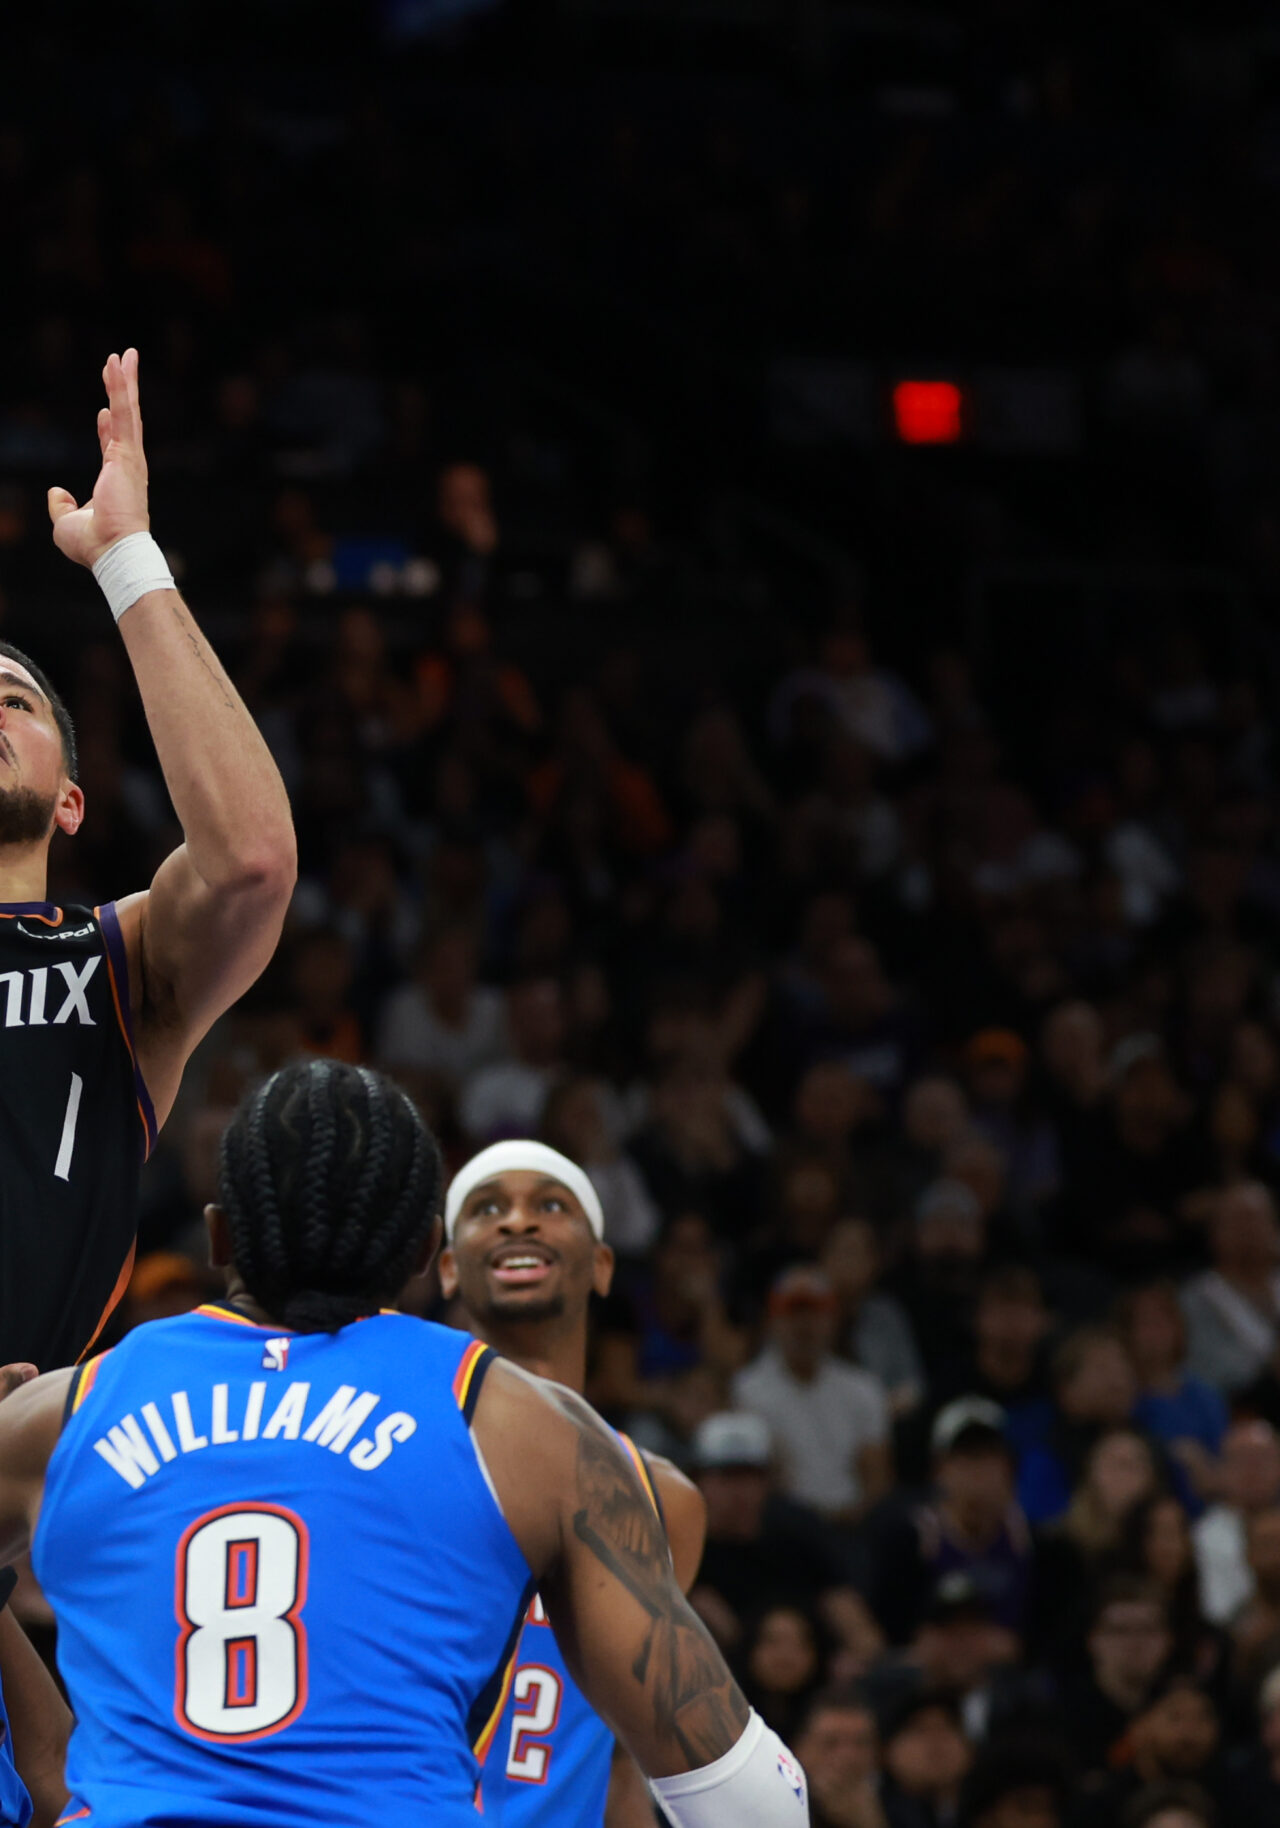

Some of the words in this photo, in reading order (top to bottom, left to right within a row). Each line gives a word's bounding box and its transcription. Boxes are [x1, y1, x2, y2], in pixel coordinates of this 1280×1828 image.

[52, 1070, 84, 1183] 1
[93, 1381, 418, 1490] WILLIAMS
[174, 1501, 309, 1744] 8
[506, 1662, 564, 1786] 2
